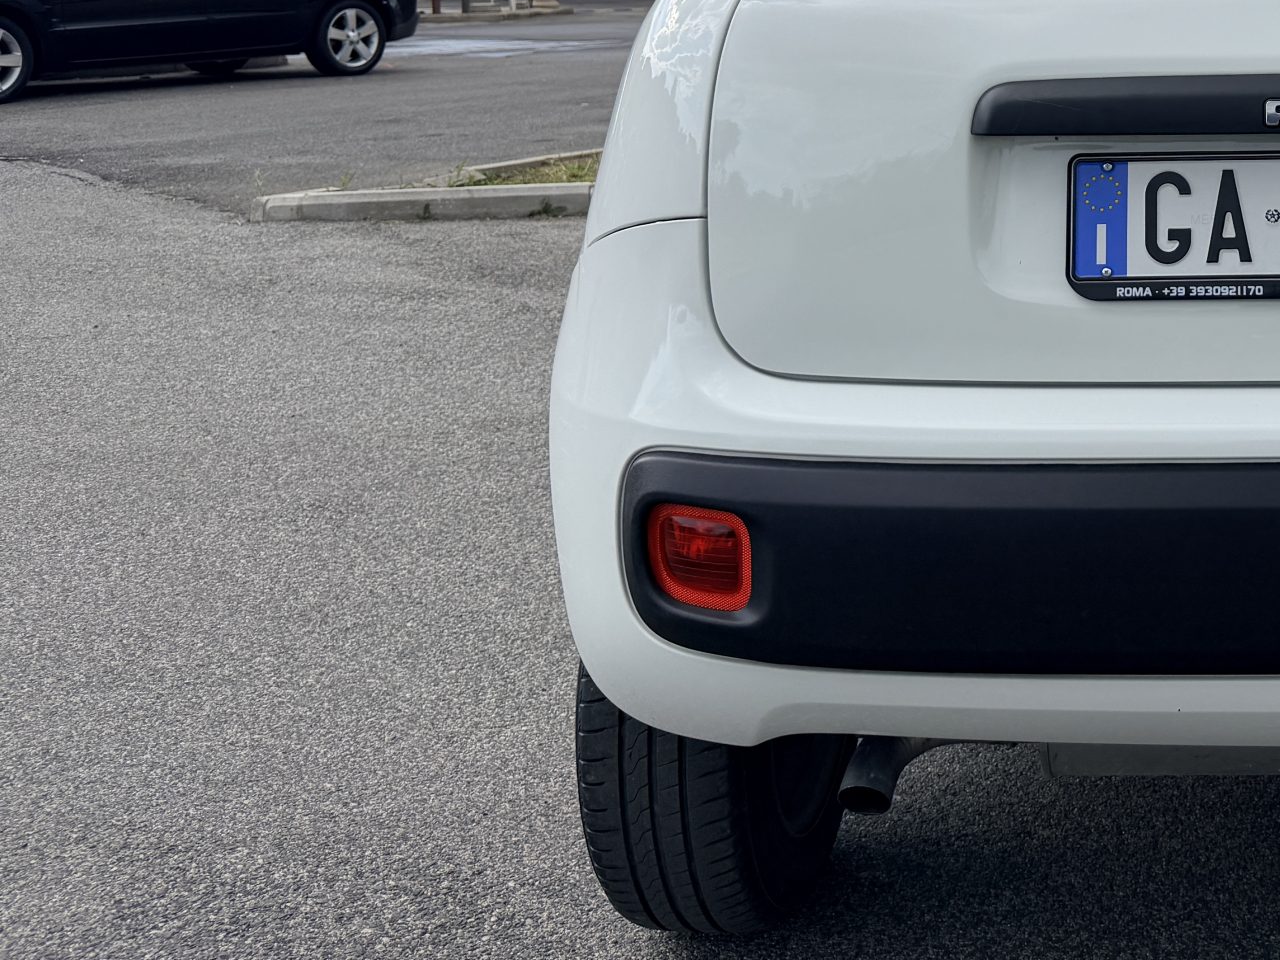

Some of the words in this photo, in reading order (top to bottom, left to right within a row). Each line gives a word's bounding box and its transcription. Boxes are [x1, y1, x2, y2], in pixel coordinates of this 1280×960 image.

[1145, 169, 1252, 265] GA
[1116, 287, 1152, 297] ROMA
[1162, 286, 1186, 296] +39
[1189, 285, 1264, 296] 3930921170
